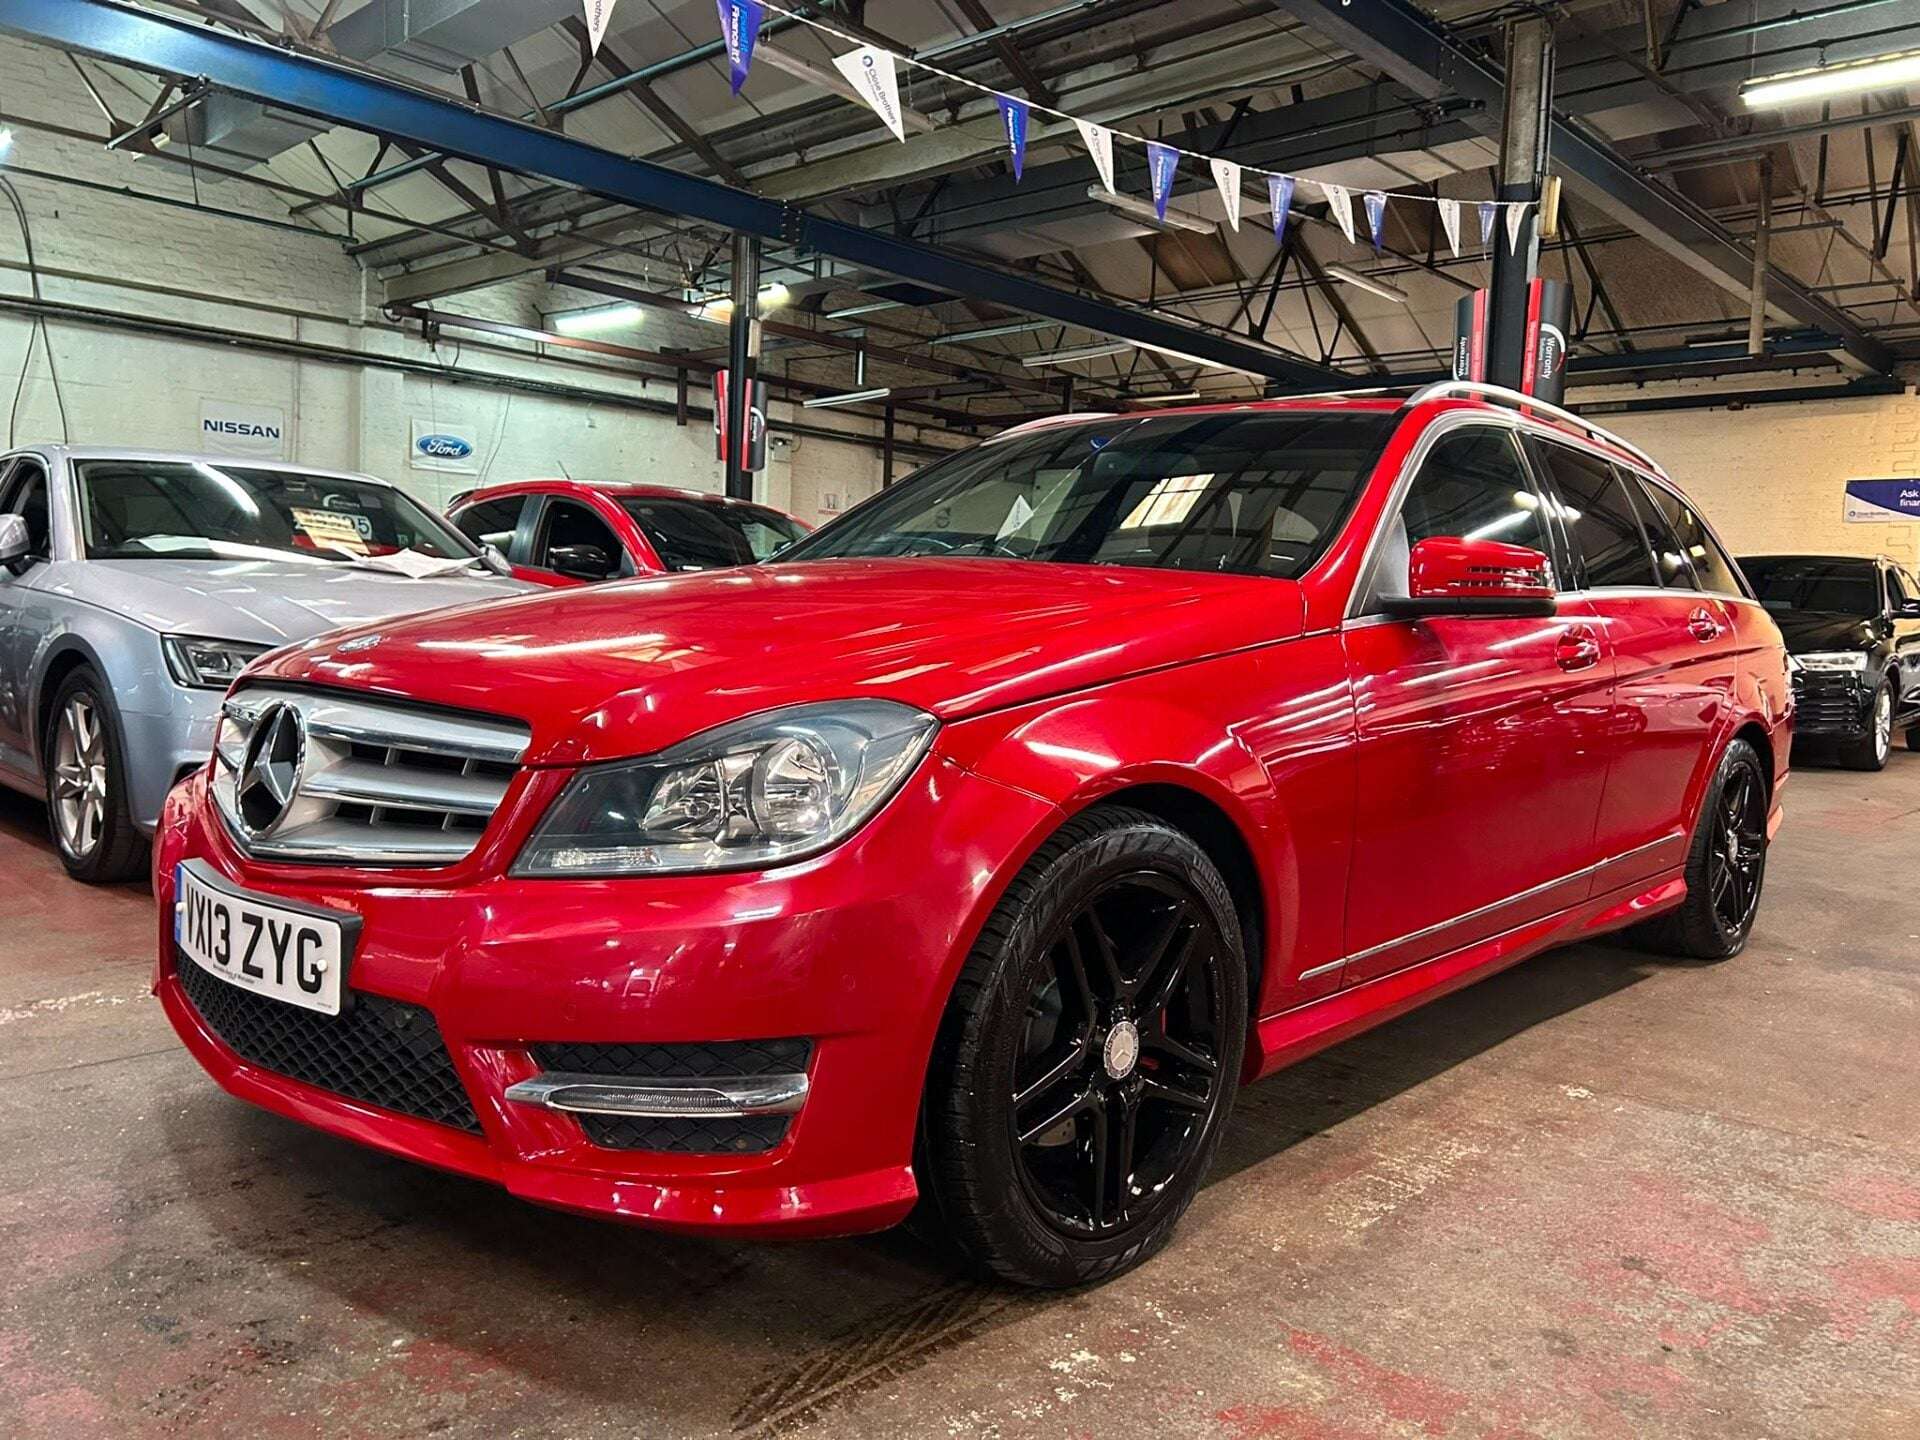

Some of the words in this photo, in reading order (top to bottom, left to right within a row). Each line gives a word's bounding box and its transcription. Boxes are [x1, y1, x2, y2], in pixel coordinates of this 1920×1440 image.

[592, 0, 603, 33] others
[731, 5, 740, 47] Finance
[869, 68, 882, 93] Close
[879, 90, 897, 125] Brothers
[1541, 336, 1556, 380] Warranty
[203, 419, 280, 439] NISSAN
[427, 439, 462, 457] Ford
[1899, 489, 1919, 498] Ask
[186, 882, 231, 966] VX13
[241, 911, 323, 994] ZYG
